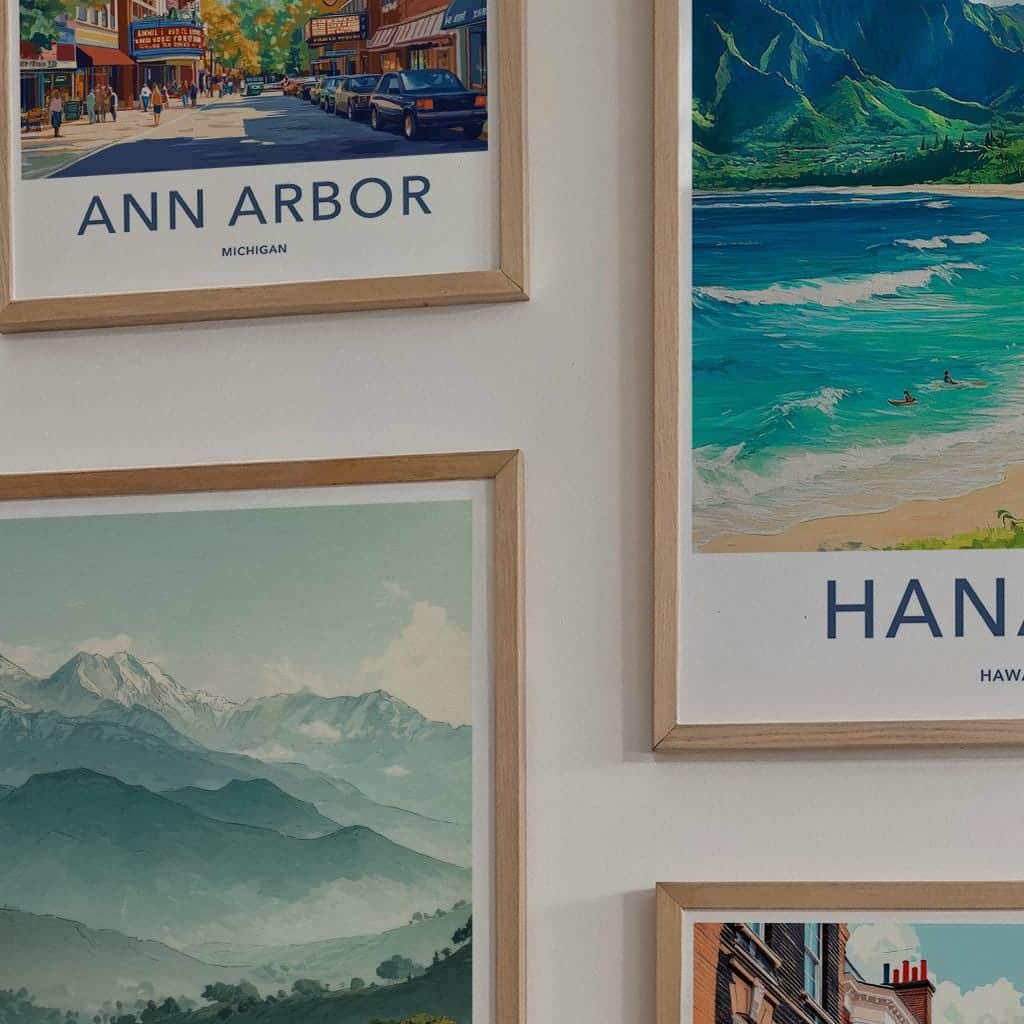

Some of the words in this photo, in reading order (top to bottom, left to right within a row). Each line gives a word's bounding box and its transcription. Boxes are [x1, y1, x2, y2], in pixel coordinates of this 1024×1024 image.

[77, 187, 205, 236] ANN
[228, 175, 432, 227] ARBOR
[221, 244, 288, 257] MICHIGAN
[827, 577, 1024, 639] HAN
